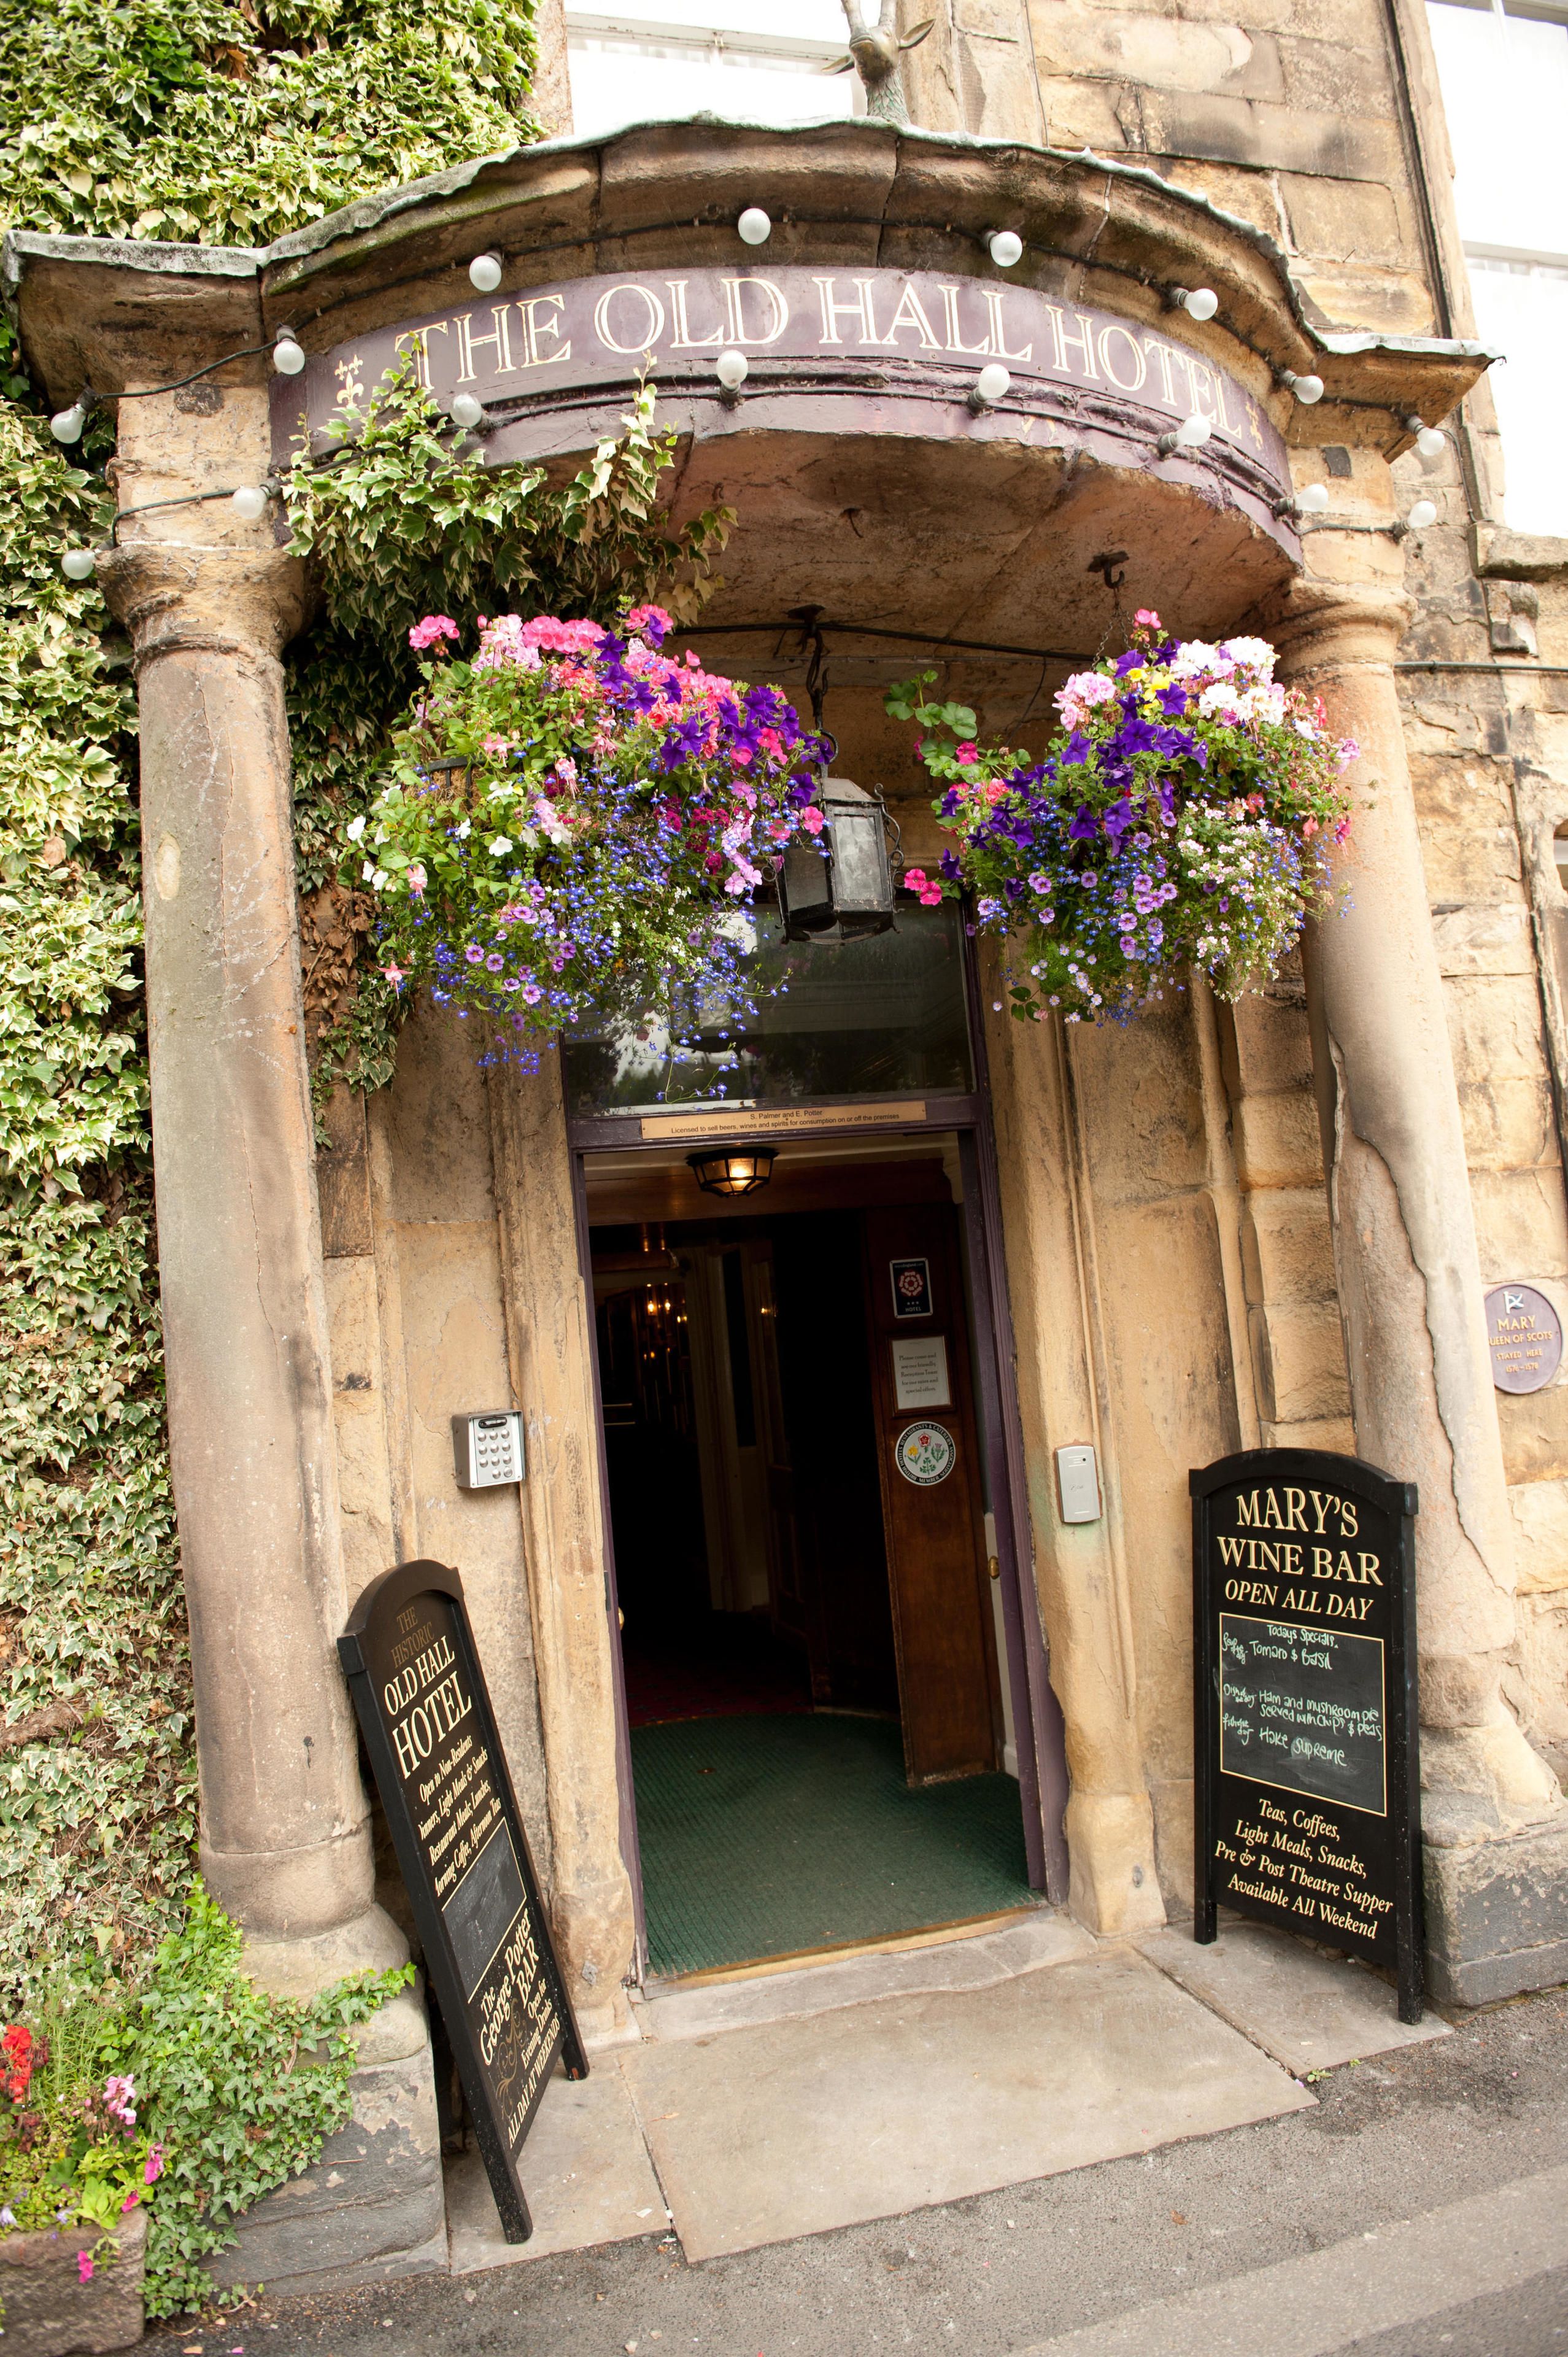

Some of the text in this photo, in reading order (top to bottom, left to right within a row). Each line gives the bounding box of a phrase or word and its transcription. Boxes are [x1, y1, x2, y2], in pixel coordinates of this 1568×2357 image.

[395, 277, 1243, 440] THE OLD HALL HOTEL
[1489, 1331, 1552, 1346] UEEN OF SCOTS
[1497, 1315, 1536, 1332] MARY
[1496, 1348, 1543, 1361] STAYED HERE
[1236, 1487, 1359, 1538] MARY'S
[1217, 1536, 1384, 1586] WINE BAR
[396, 1606, 418, 1635] THE
[1225, 1579, 1374, 1620] OPEN ALL DAY
[390, 1621, 434, 1670] HISTORIC
[1267, 1625, 1297, 1644] Todays
[1302, 1648, 1332, 1670] Basil
[384, 1635, 455, 1716] OLD HALL
[1259, 1690, 1281, 1706] Ham
[1283, 1697, 1303, 1710] and
[392, 1670, 473, 1781] HOTEL
[1259, 1726, 1289, 1749] Hake
[418, 1746, 488, 1841] inners, Light Meals & Snacks
[420, 1735, 473, 1806] Open to Non-Residents
[429, 1820, 457, 1867] Restaurant
[471, 1779, 491, 1810] Lunches,
[454, 1840, 472, 1868] Coffee,
[470, 1809, 492, 1849] Afternoon
[490, 1797, 501, 1817] Teas
[1259, 1798, 1340, 1841] Teas, Coffees,
[1235, 1819, 1367, 1879] Light Meals, Snacks,
[1215, 1840, 1394, 1915] Pre & Post Theatre Supper
[1227, 1873, 1378, 1940] Available All Weekend
[480, 1907, 531, 2067] George Potter
[517, 1936, 540, 2010] BAR
[527, 1978, 547, 2019] Open for
[481, 1984, 496, 2021] The
[521, 1999, 552, 2070] Evening Drinks
[508, 2011, 561, 2149] ALL DAY AT WEEKENDS
